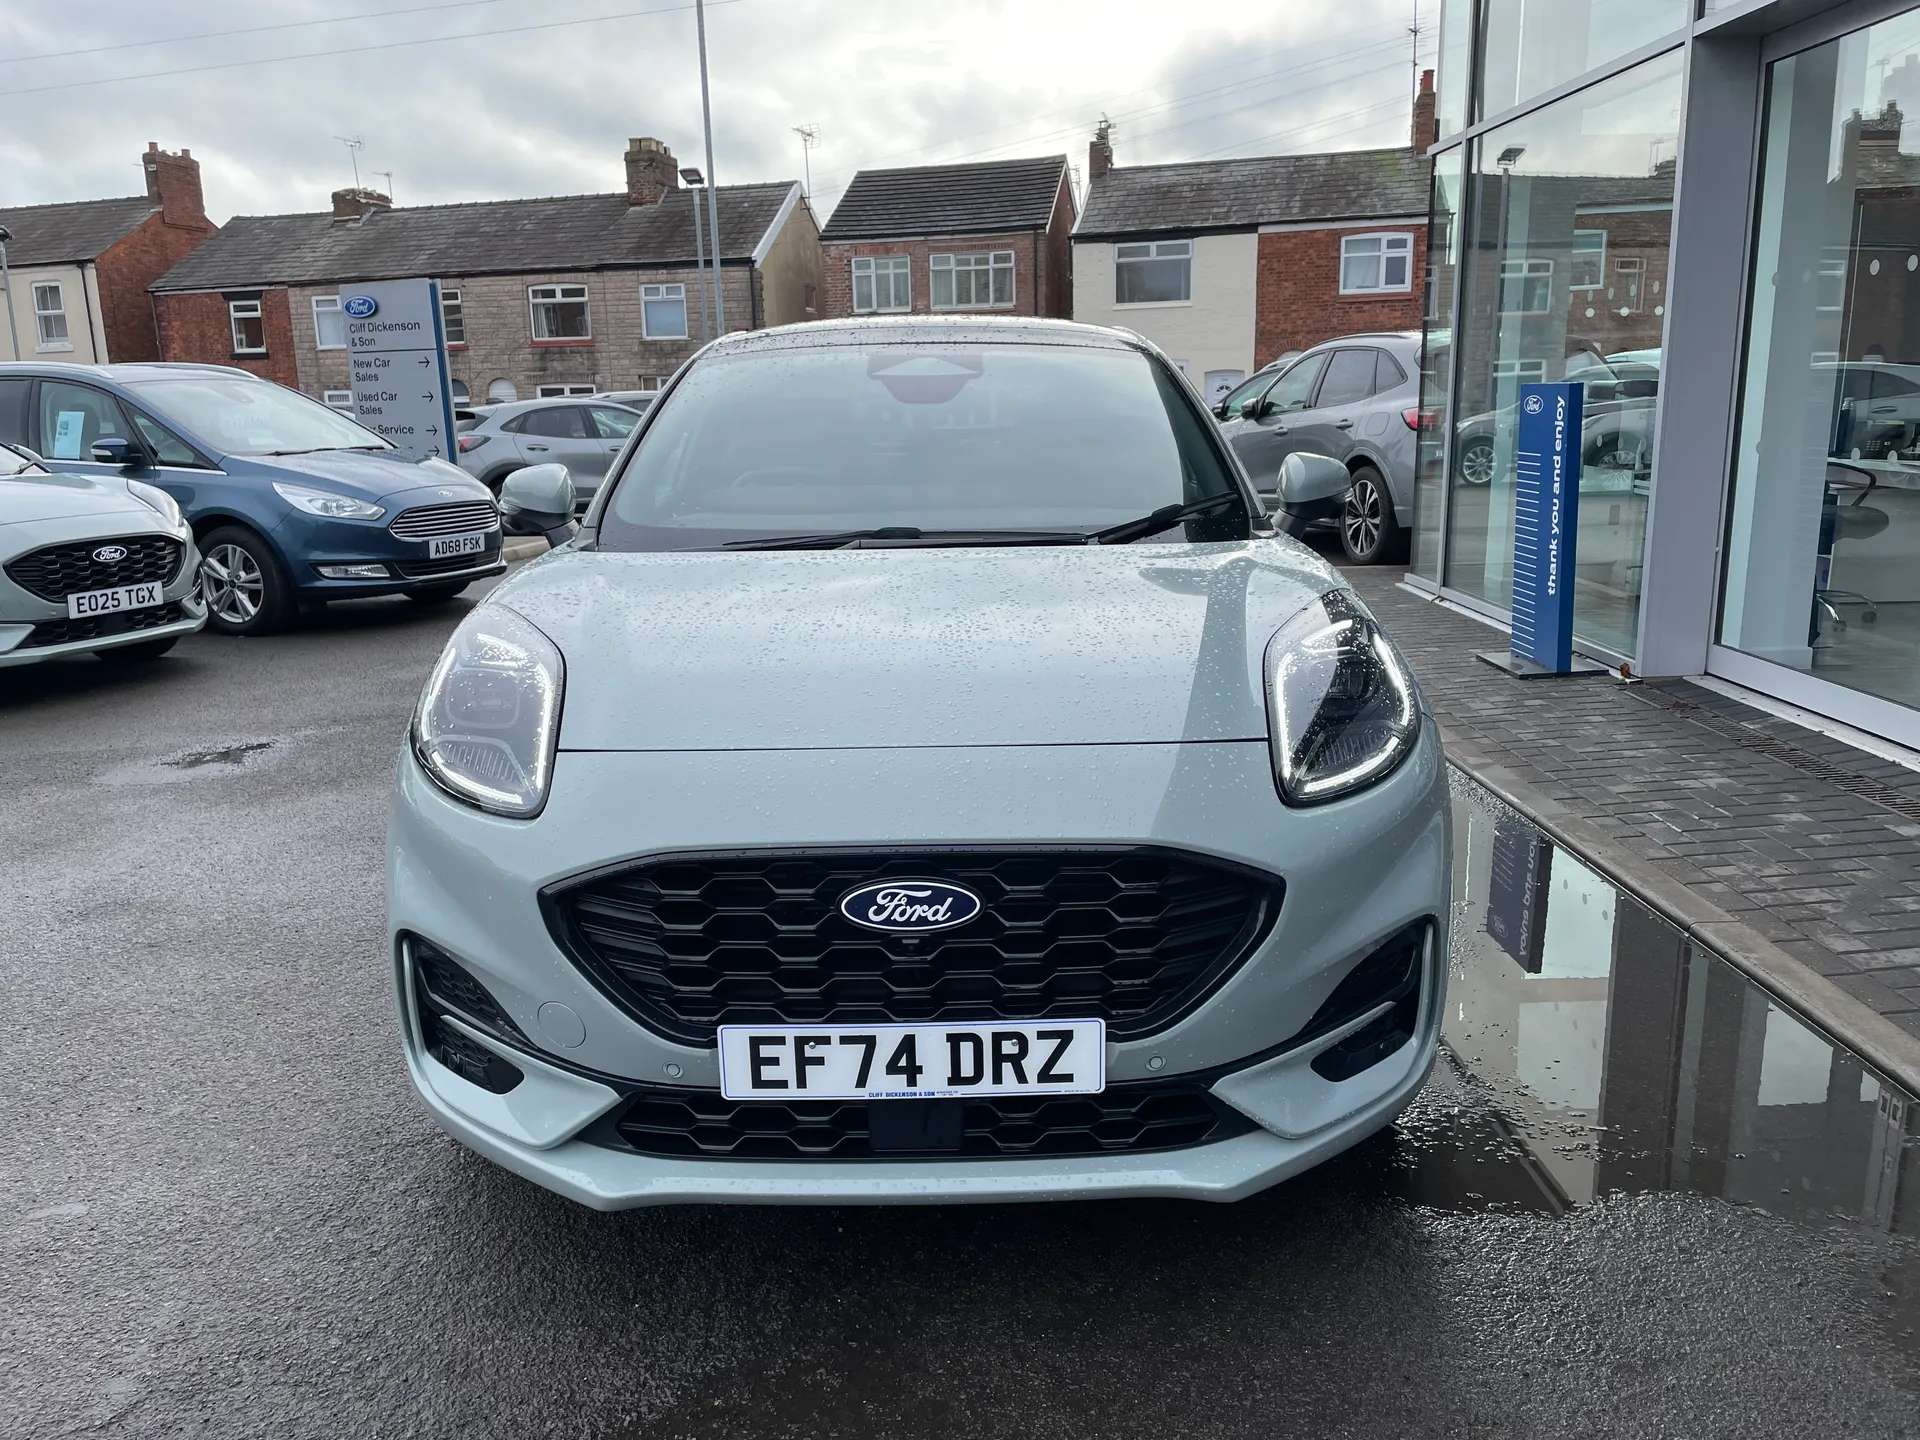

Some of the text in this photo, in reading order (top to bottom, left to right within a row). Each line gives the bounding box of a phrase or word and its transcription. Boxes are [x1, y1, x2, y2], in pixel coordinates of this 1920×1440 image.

[349, 321, 420, 333] Cliff Dickenson
[351, 336, 376, 347] & Son
[353, 357, 390, 368] New Car
[355, 371, 379, 382] Sales
[357, 391, 397, 401] Used Car
[359, 404, 383, 415] Sales
[377, 424, 414, 434] Service
[1547, 395, 1565, 596] thank you and enjoy
[434, 536, 481, 555] AD68 FSK
[76, 586, 157, 614] EO25 TGX
[868, 888, 954, 922] Ford
[748, 1029, 1075, 1089] EF74 DRZ
